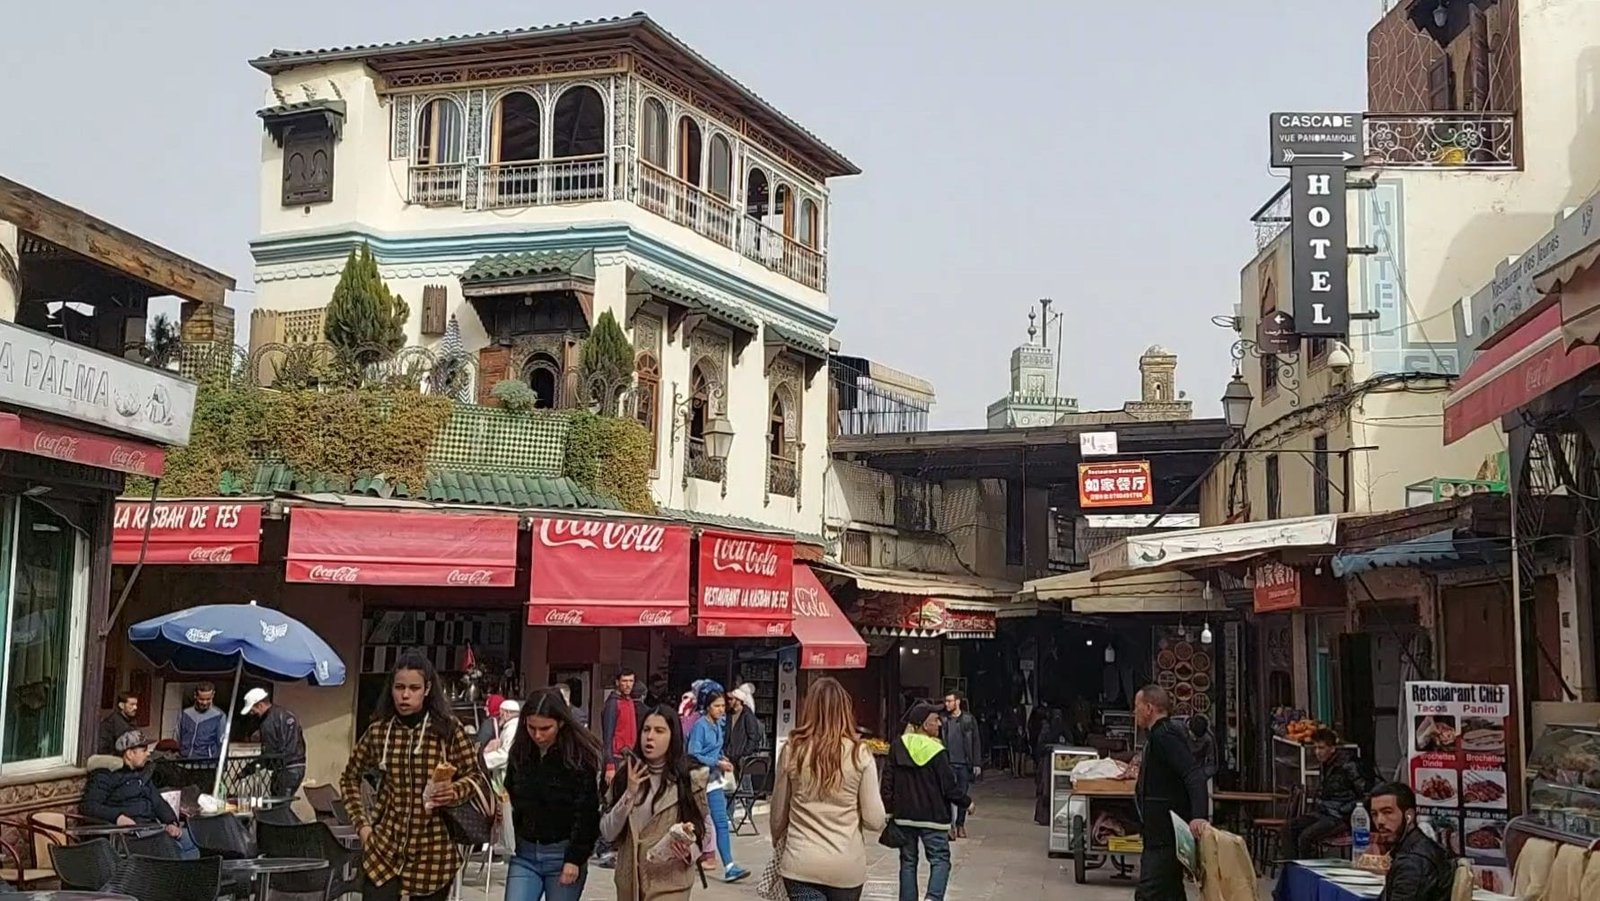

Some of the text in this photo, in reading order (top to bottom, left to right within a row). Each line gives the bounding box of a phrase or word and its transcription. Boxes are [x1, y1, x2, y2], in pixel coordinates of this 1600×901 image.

[1279, 115, 1353, 127] CASCADE
[1279, 134, 1357, 142] VUE PANORAMIQUE
[1307, 173, 1332, 325] HOTEL
[1491, 263, 1523, 300] Restaurant
[1523, 255, 1536, 275] des
[24, 349, 109, 407] PALMA
[113, 506, 131, 529] LA
[189, 506, 210, 529] DE
[215, 504, 242, 528] FES
[704, 586, 789, 609] RESTAURANT LA KASBAH DE FES
[1412, 684, 1476, 702] Retsuarant
[1416, 704, 1448, 713] Tacos
[1463, 704, 1498, 714] Panini
[1420, 752, 1456, 761] rochettes
[1466, 753, 1505, 763] Brochettes
